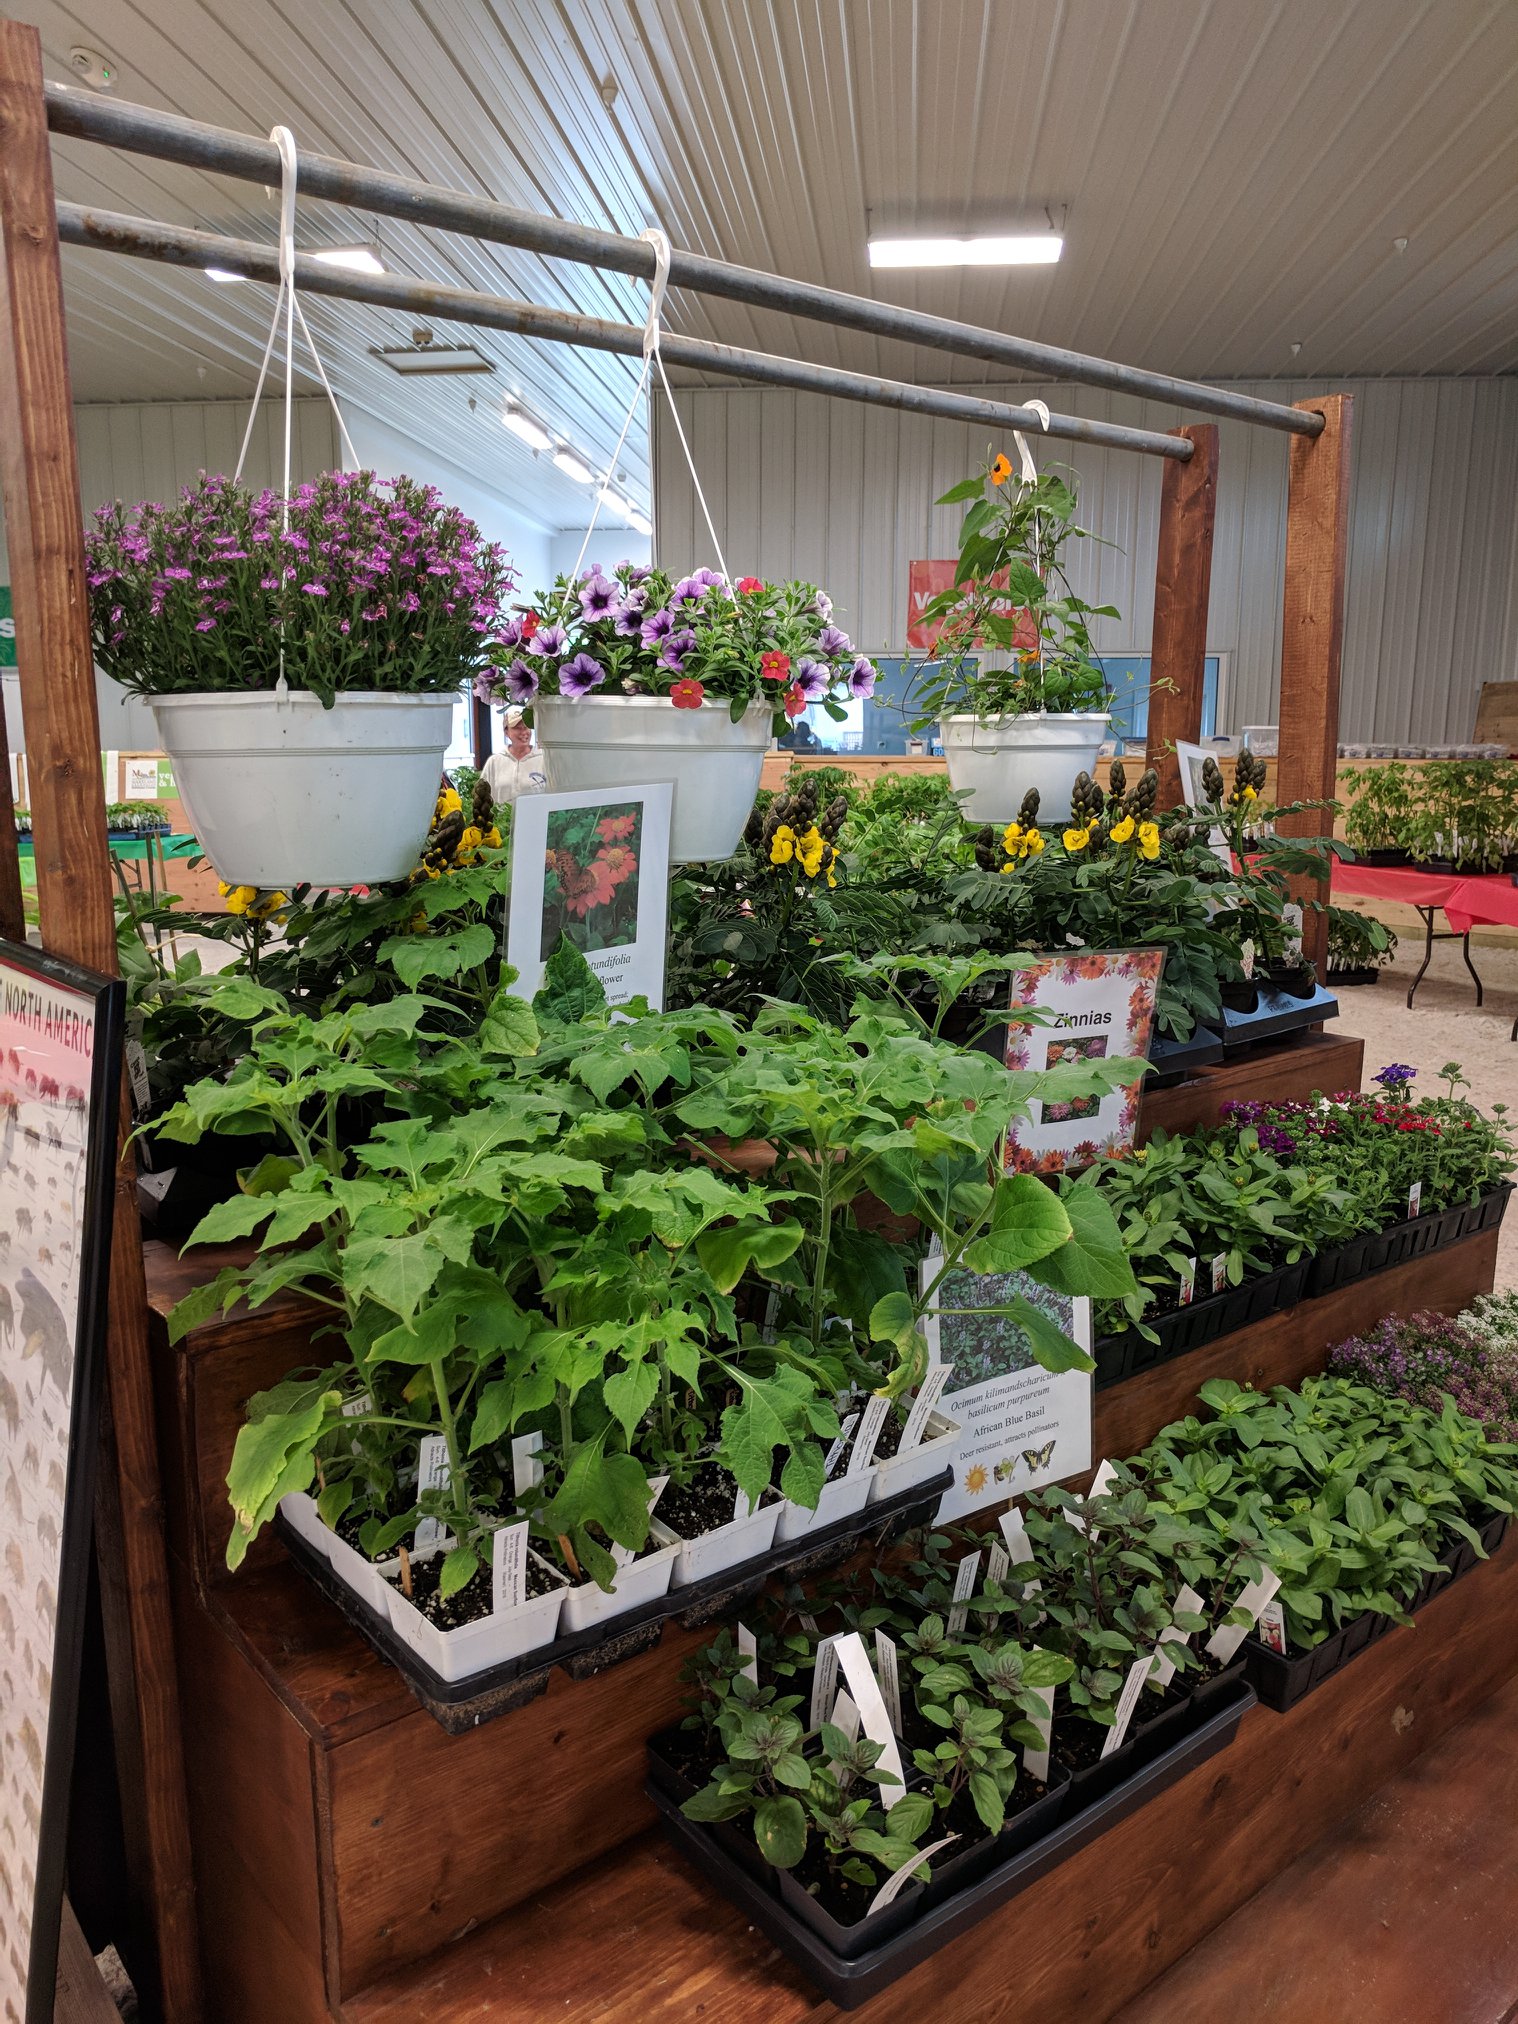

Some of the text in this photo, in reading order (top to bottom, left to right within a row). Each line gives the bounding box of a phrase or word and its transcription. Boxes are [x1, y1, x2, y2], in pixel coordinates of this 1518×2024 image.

[599, 974, 624, 986] flower
[5, 982, 42, 1032] NORTH
[44, 1000, 93, 1058] AMERIC
[1053, 1009, 1112, 1030] Zinnias
[950, 1394, 984, 1413] Ocimum
[967, 1386, 1051, 1420] basilicum purpureum
[972, 1405, 1046, 1438] African Blue Basil
[959, 1420, 1060, 1461] Deer resistant, attracts pollinators
